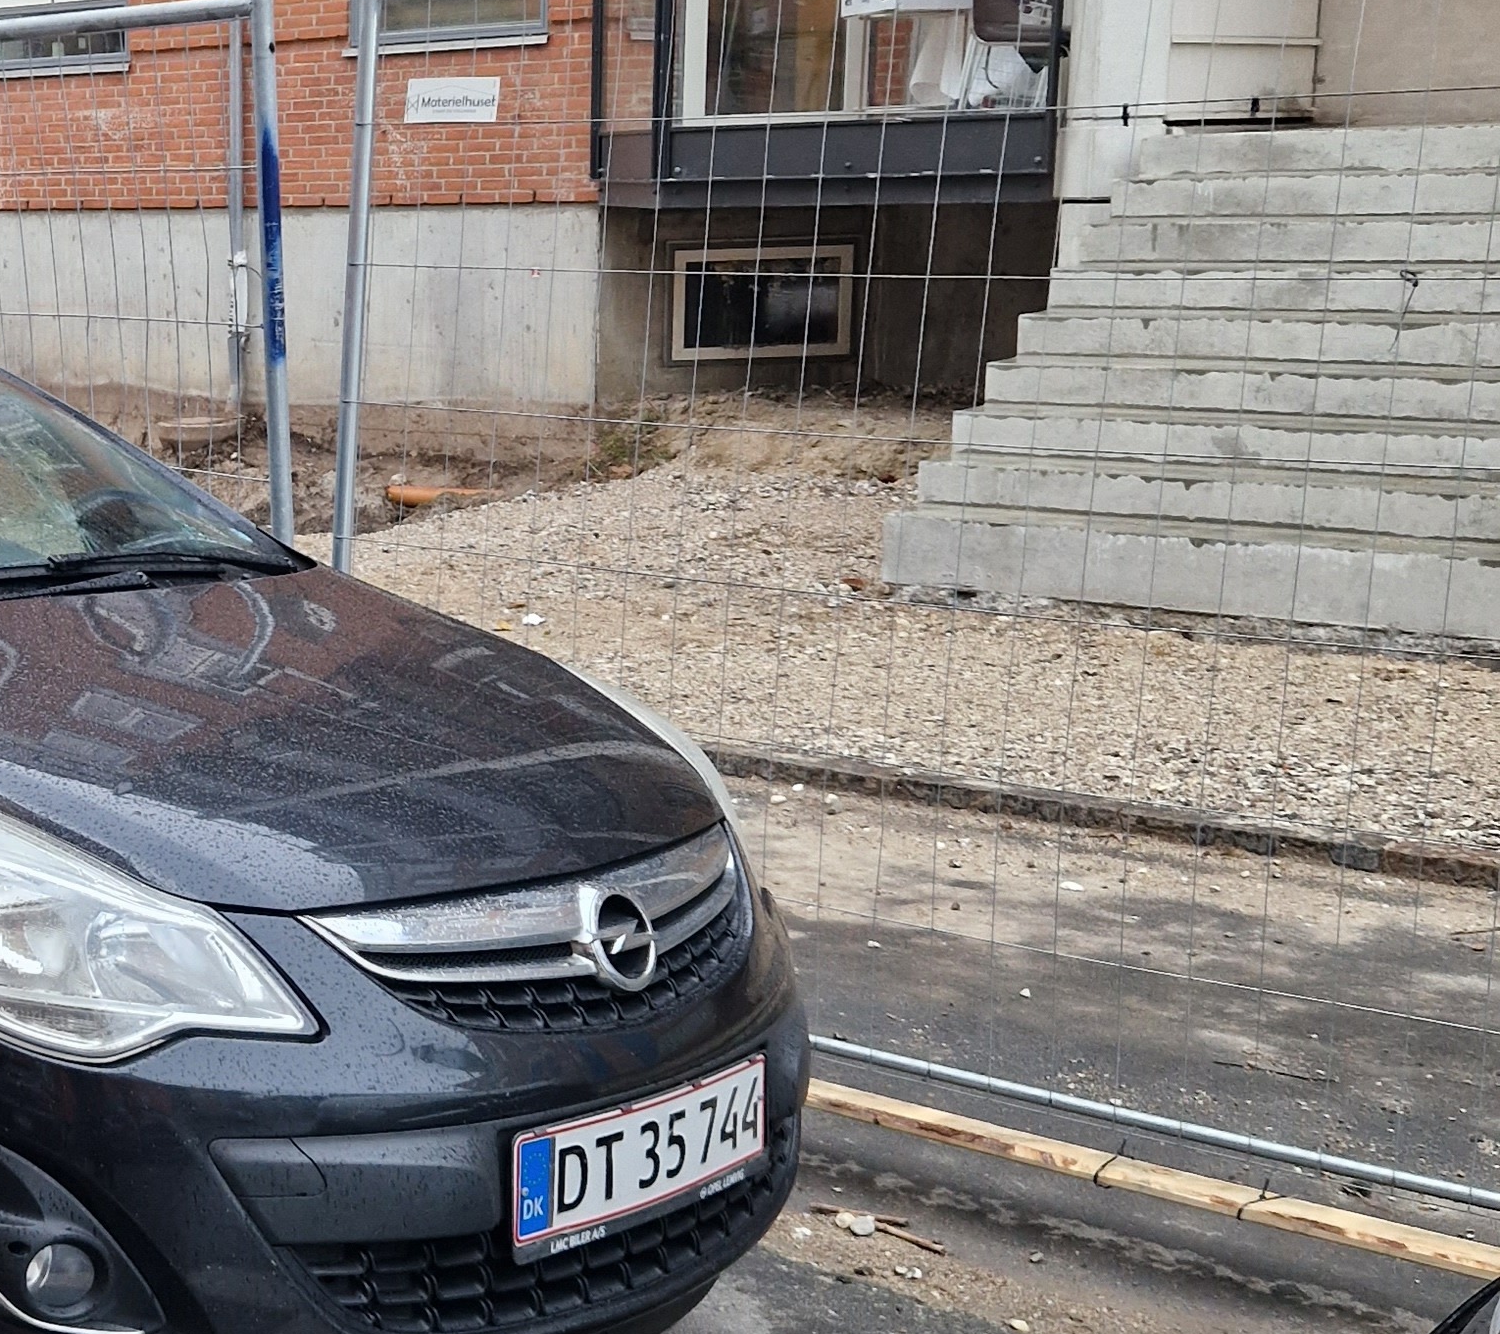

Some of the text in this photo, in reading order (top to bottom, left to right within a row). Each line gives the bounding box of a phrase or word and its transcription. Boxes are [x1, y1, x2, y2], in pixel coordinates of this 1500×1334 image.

[421, 94, 496, 108] Materielhuset
[557, 1075, 759, 1214] DT 35 744
[523, 1195, 544, 1220] DK
[550, 1236, 569, 1254] LMC
[569, 1229, 591, 1248] BILER
